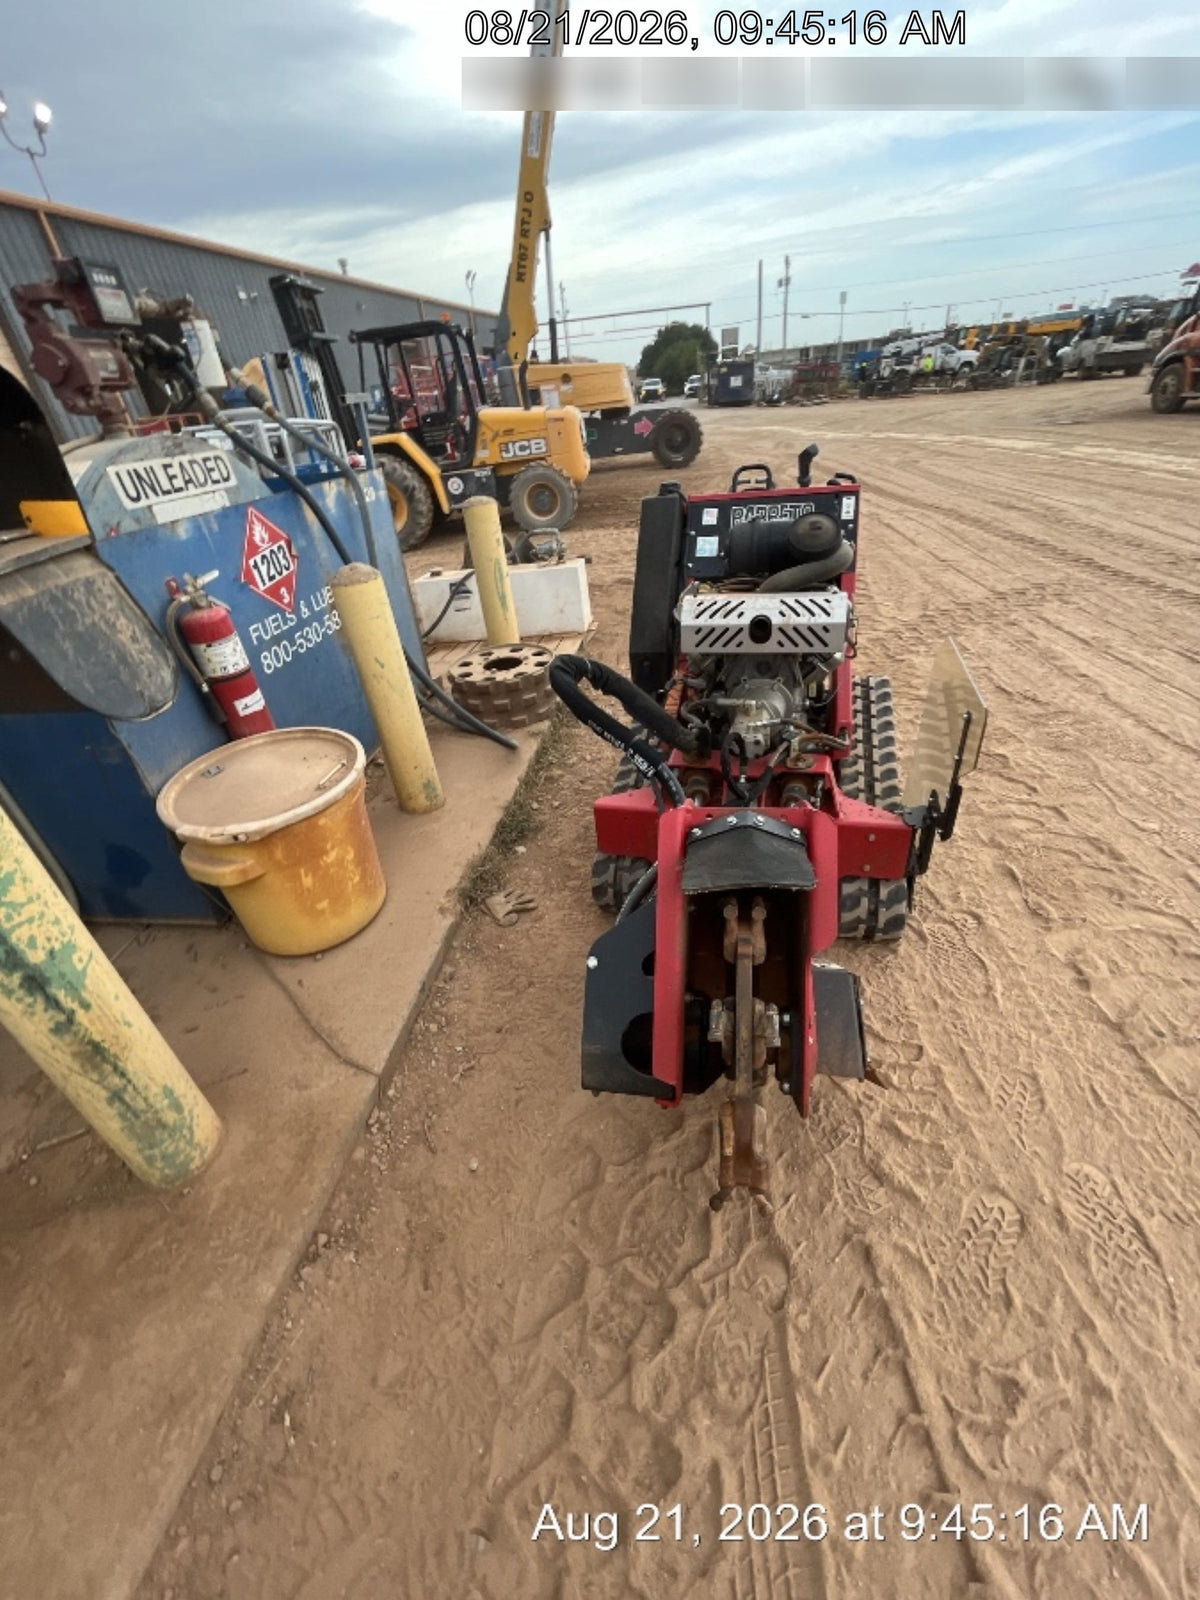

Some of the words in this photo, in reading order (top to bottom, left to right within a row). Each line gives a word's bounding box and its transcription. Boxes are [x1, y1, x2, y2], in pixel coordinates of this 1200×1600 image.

[501, 438, 547, 459] JCB
[115, 454, 232, 504] UNLEADED
[252, 545, 291, 587] 1203
[248, 611, 298, 645] FUELS
[299, 600, 311, 619] &
[310, 585, 335, 611] LUB
[280, 587, 291, 604] 3
[260, 609, 342, 675] 800-530-58
